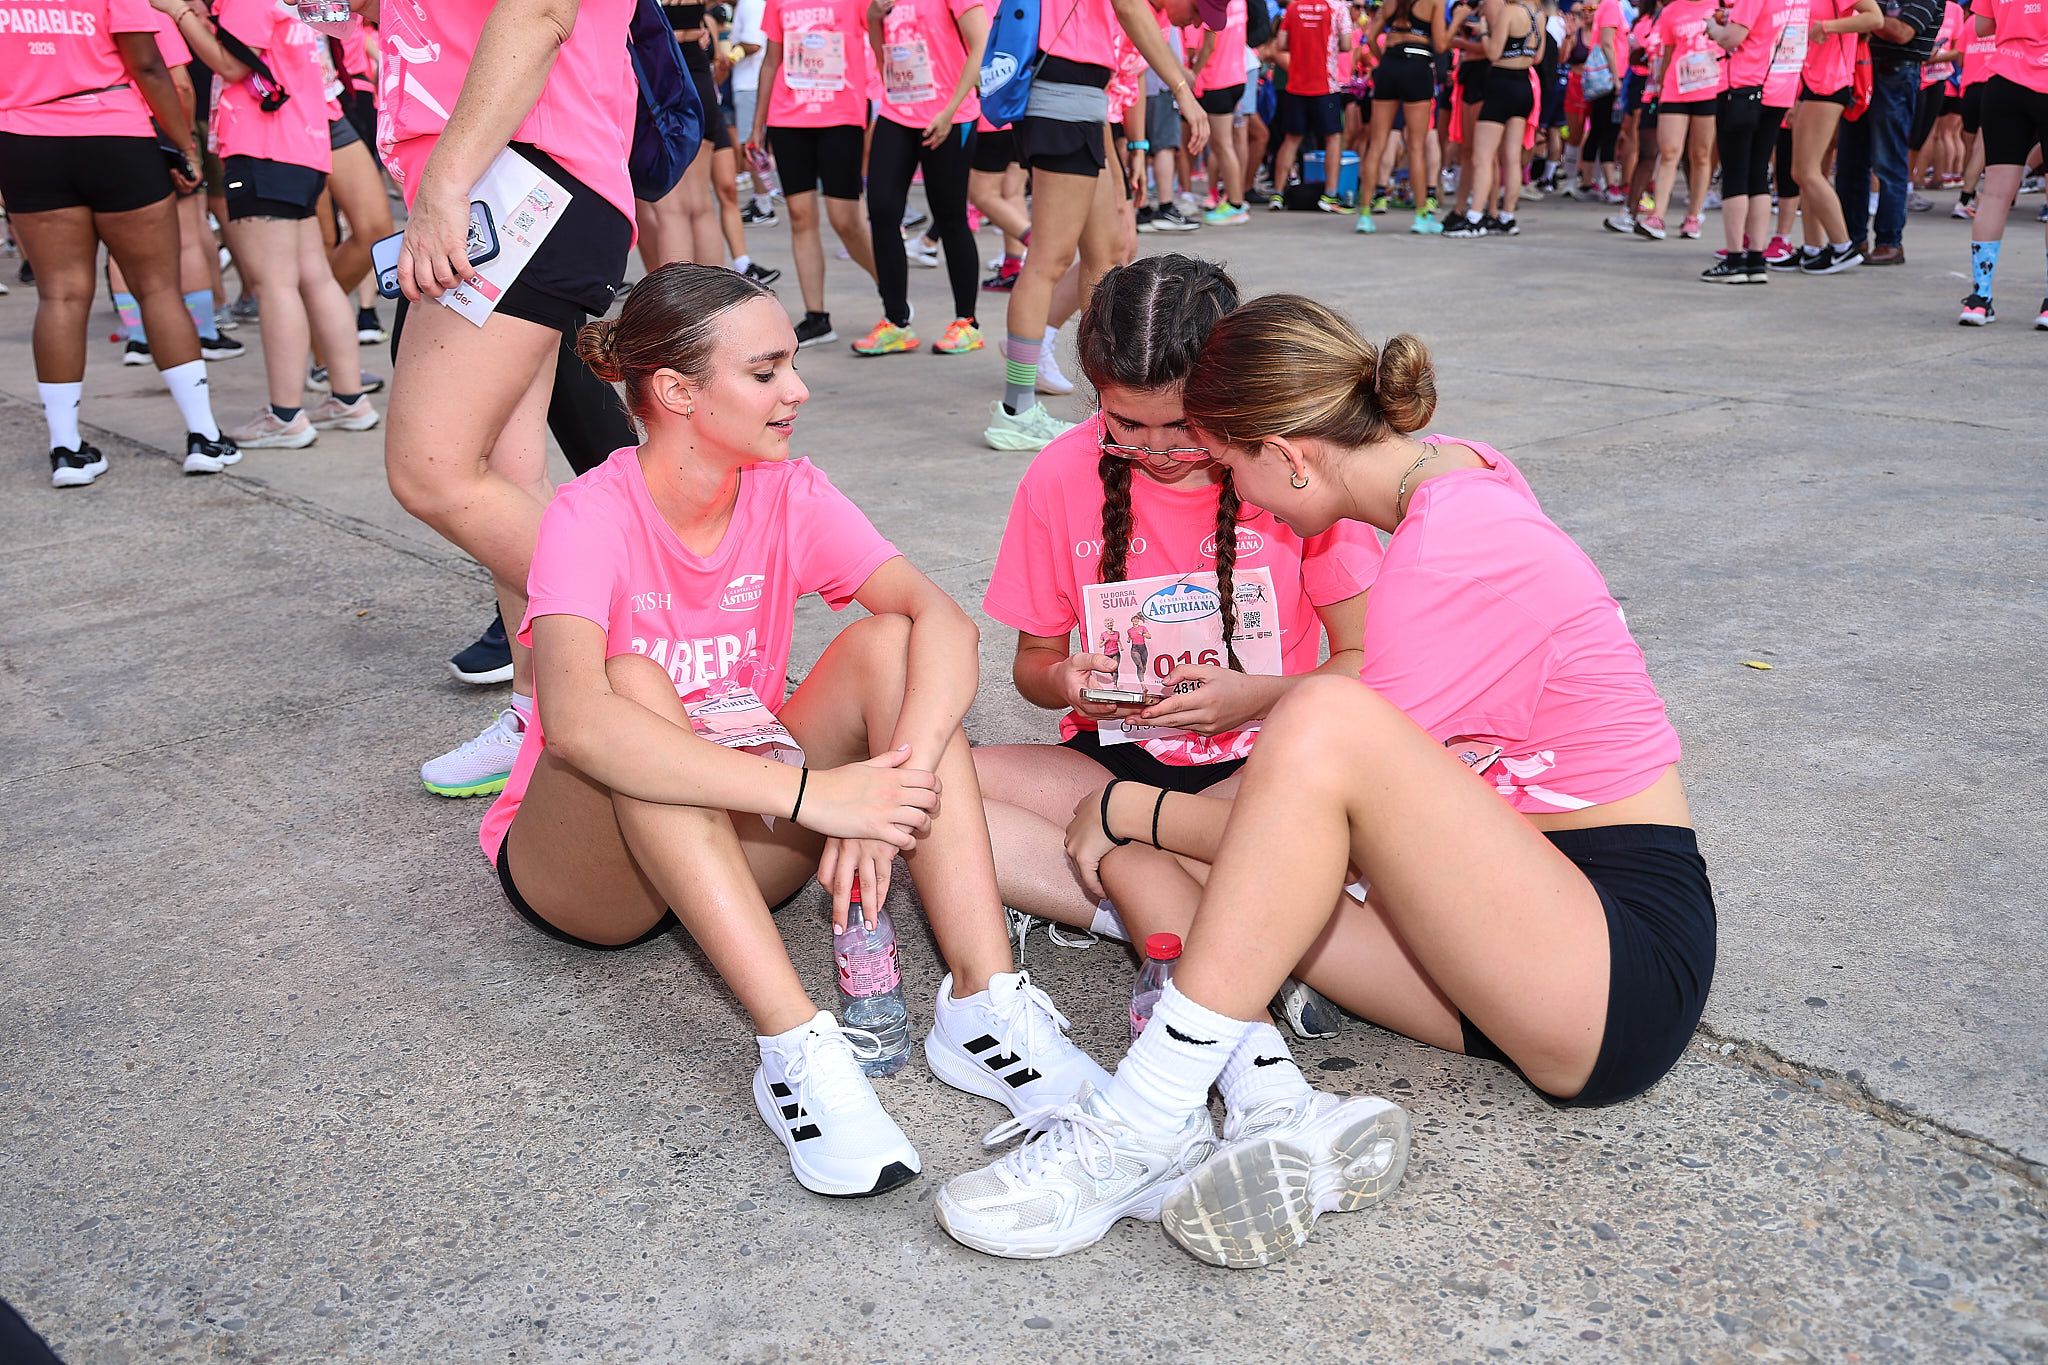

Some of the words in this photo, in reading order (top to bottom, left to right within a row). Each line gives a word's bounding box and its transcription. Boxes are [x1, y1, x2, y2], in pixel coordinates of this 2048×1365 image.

[0, 8, 96, 36] PARABLES
[783, 9, 834, 28] CARRERA
[28, 41, 56, 55] 2026
[804, 58, 824, 68] 016
[470, 275, 484, 290] CIA
[1075, 537, 1147, 558] OYO
[1203, 540, 1259, 553] ASIANA
[1110, 590, 1136, 598] DORSAL
[1159, 596, 1185, 604] CENTRAL
[1102, 596, 1138, 609] SUMA
[1148, 601, 1217, 617] ASTURIANA
